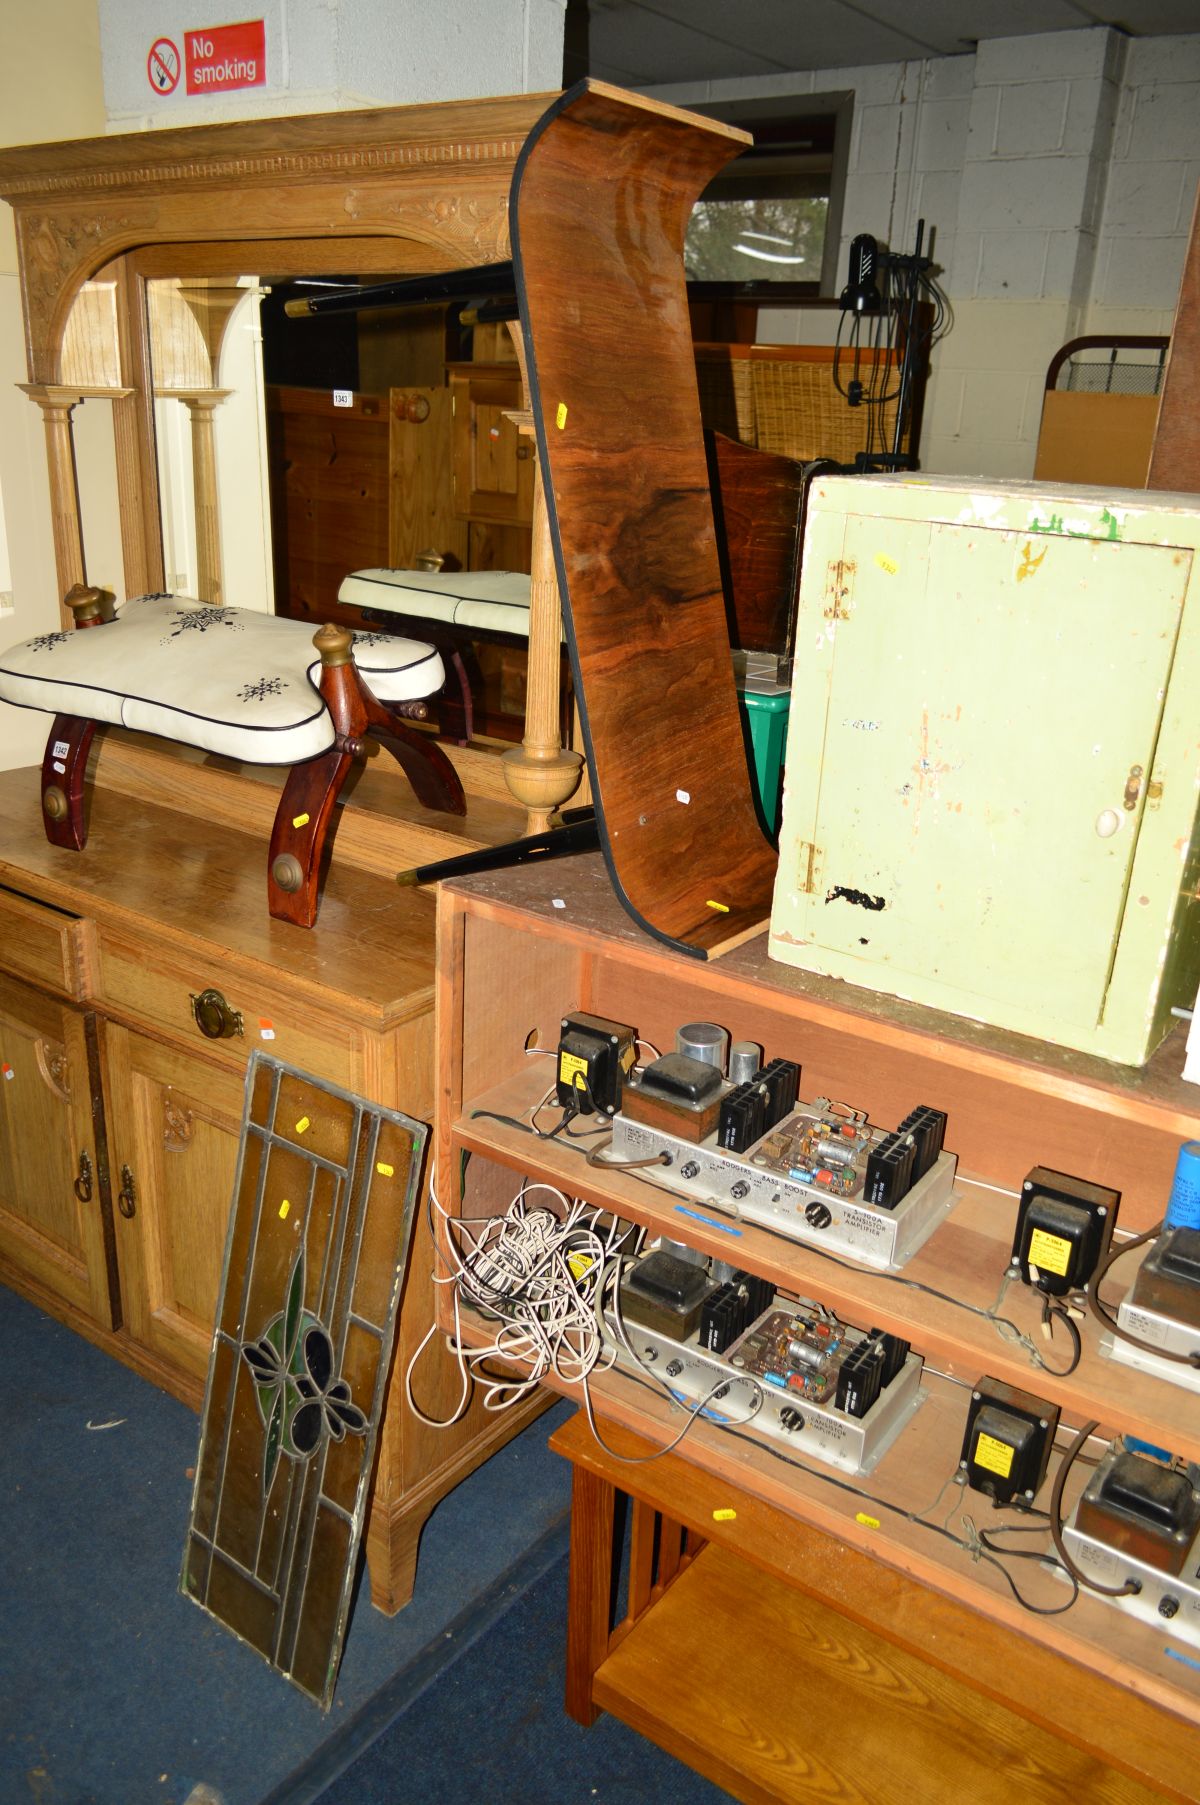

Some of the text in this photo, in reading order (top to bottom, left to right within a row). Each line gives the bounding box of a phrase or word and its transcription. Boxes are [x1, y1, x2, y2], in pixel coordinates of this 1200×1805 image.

[192, 37, 214, 59] No
[193, 58, 257, 84] smoking
[335, 394, 348, 403] 1343
[55, 745, 68, 756] 1342
[721, 1159, 752, 1176] RODGERS
[761, 1175, 779, 1187] BASS
[784, 1183, 809, 1198] BOOST
[843, 1211, 887, 1233] TRANSISTOR
[845, 1219, 881, 1238] AMPLIFIER
